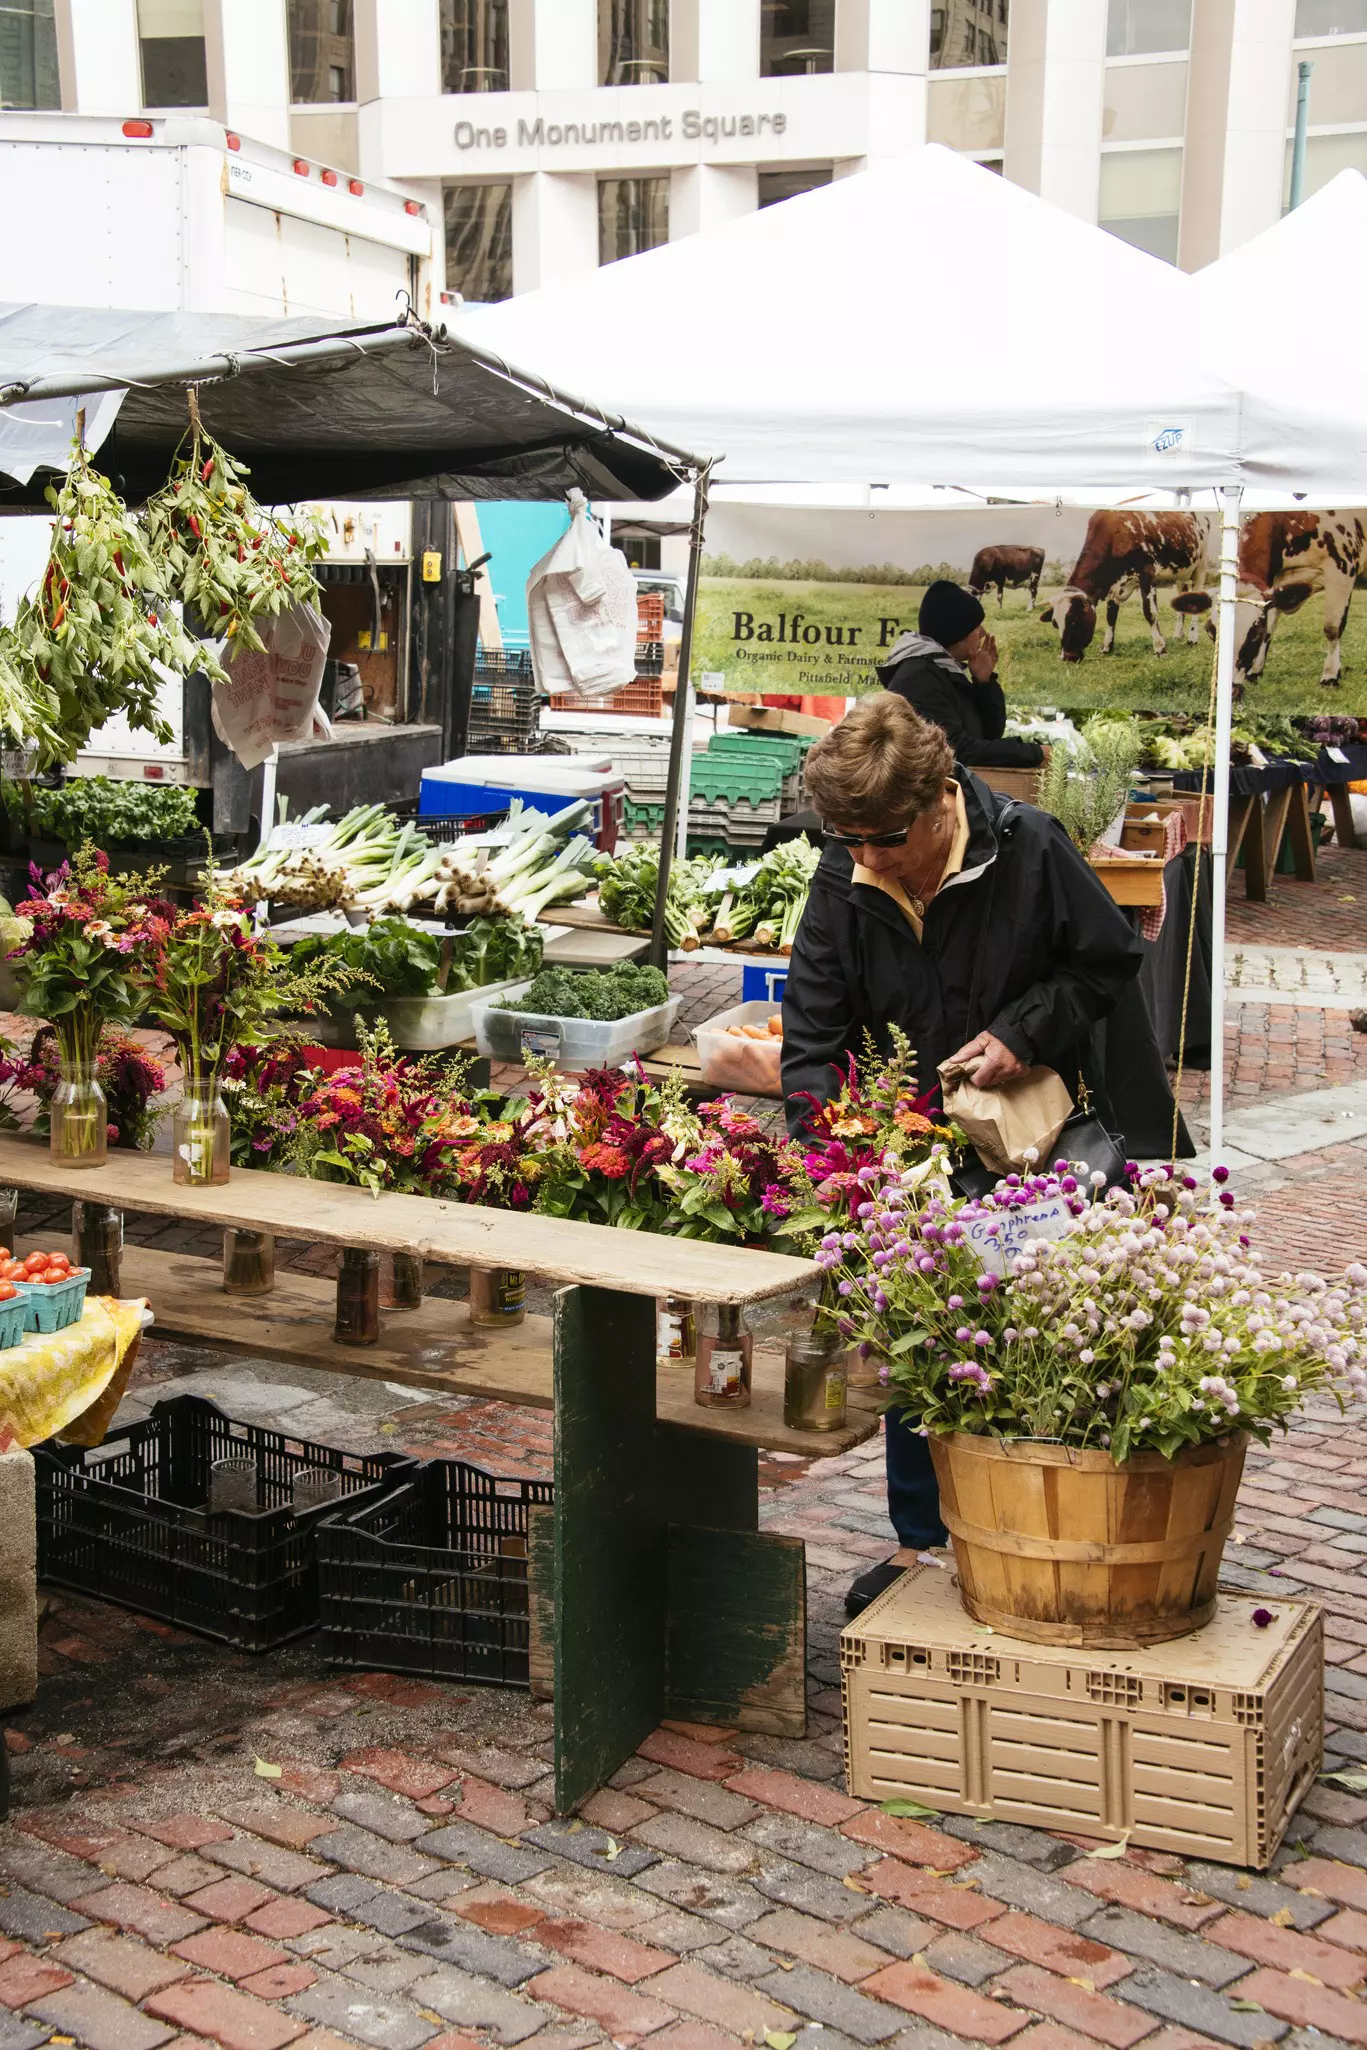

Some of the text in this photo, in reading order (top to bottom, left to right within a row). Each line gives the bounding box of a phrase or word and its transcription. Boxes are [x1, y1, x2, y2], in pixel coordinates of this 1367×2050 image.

[454, 110, 787, 149] One Monument Square
[731, 611, 914, 648] Balfour F
[736, 648, 783, 664] Organic
[787, 651, 820, 666] Dairy
[824, 653, 833, 664] &
